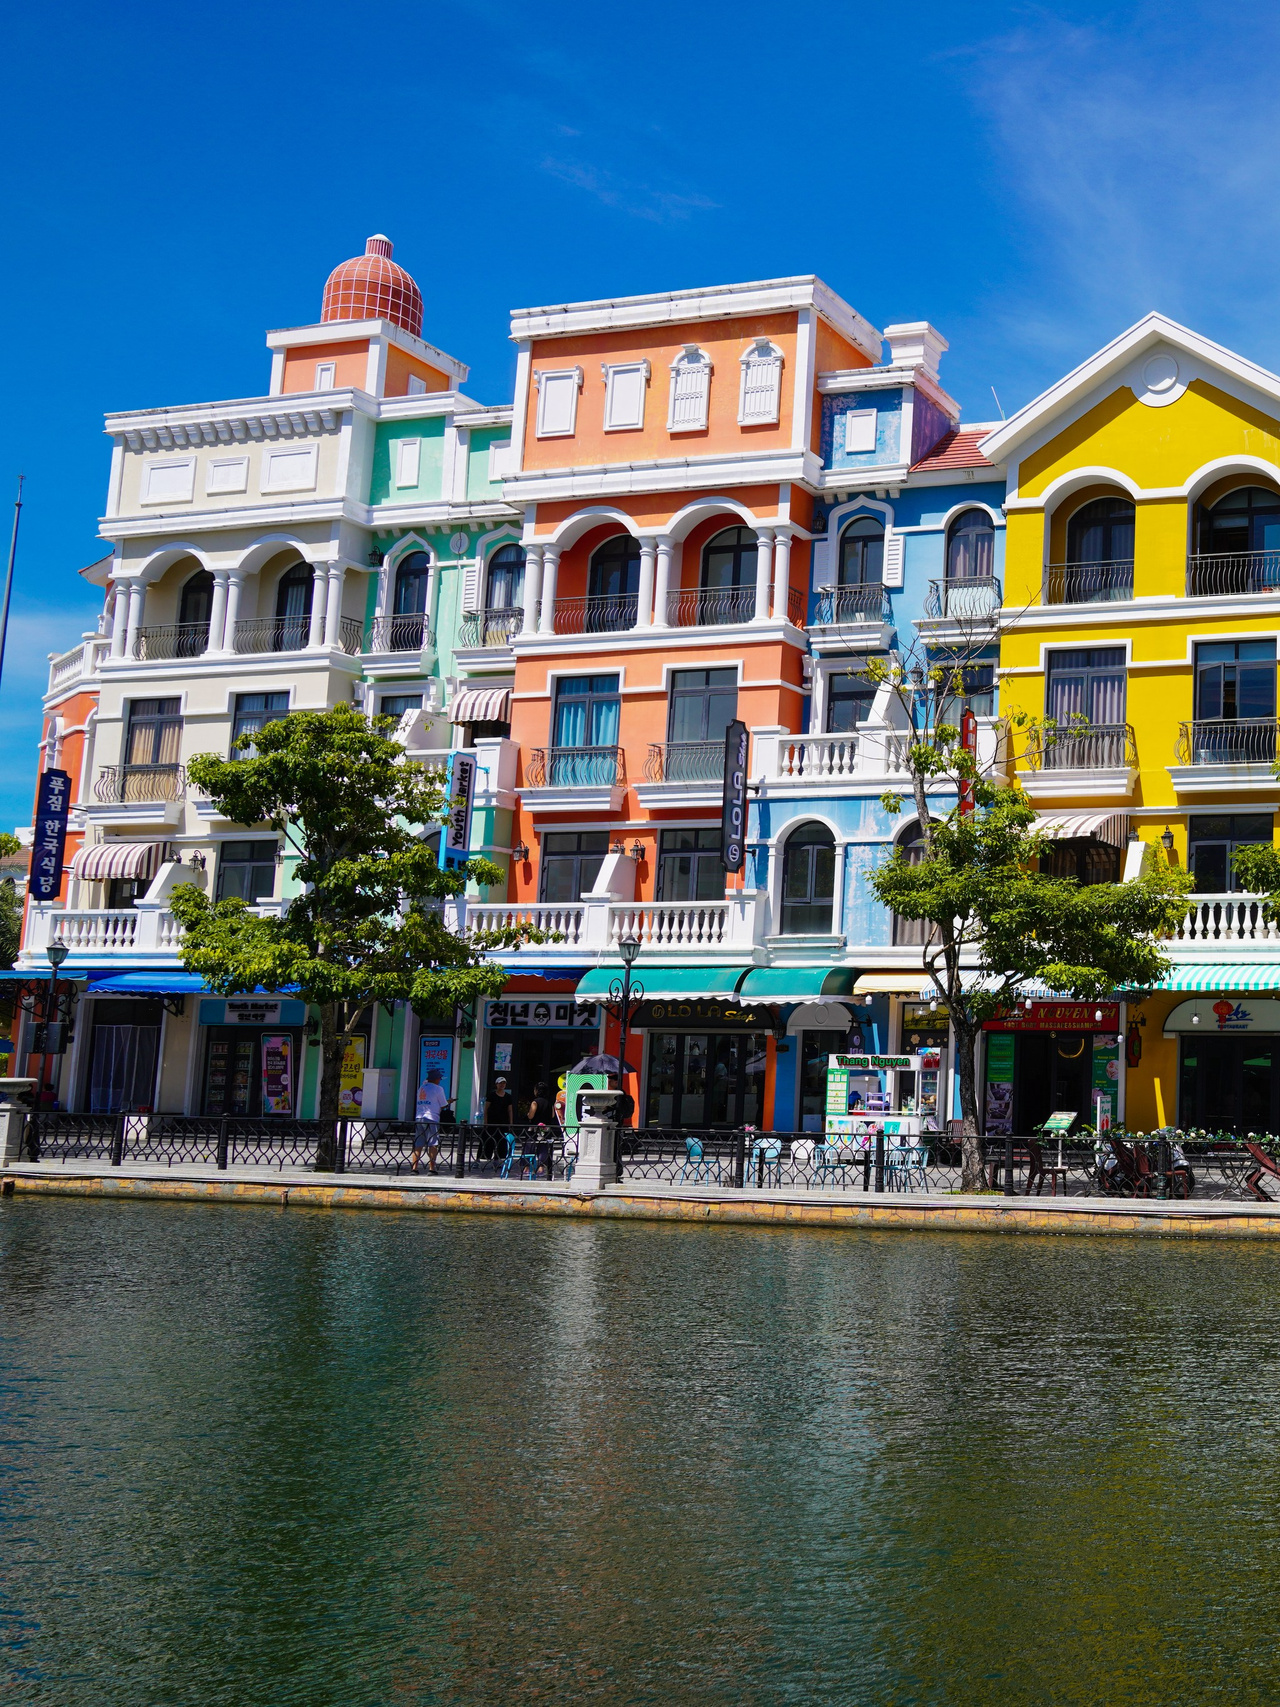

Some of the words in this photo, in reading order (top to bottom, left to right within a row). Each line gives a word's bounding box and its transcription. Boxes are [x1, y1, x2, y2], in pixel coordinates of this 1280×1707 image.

[46, 776, 65, 812] 푸짐
[456, 761, 470, 804] arket
[730, 772, 743, 840] LOLA
[452, 808, 465, 847] Youth
[39, 820, 61, 893] 한국식당
[490, 1003, 529, 1027] 청년
[555, 1003, 597, 1026] 마켓
[723, 1010, 757, 1023] Shop
[1037, 1007, 1092, 1019] NGUYEN
[1093, 1007, 1117, 1019] PA
[836, 1055, 869, 1068] Thang
[871, 1055, 911, 1069] Nguyen
